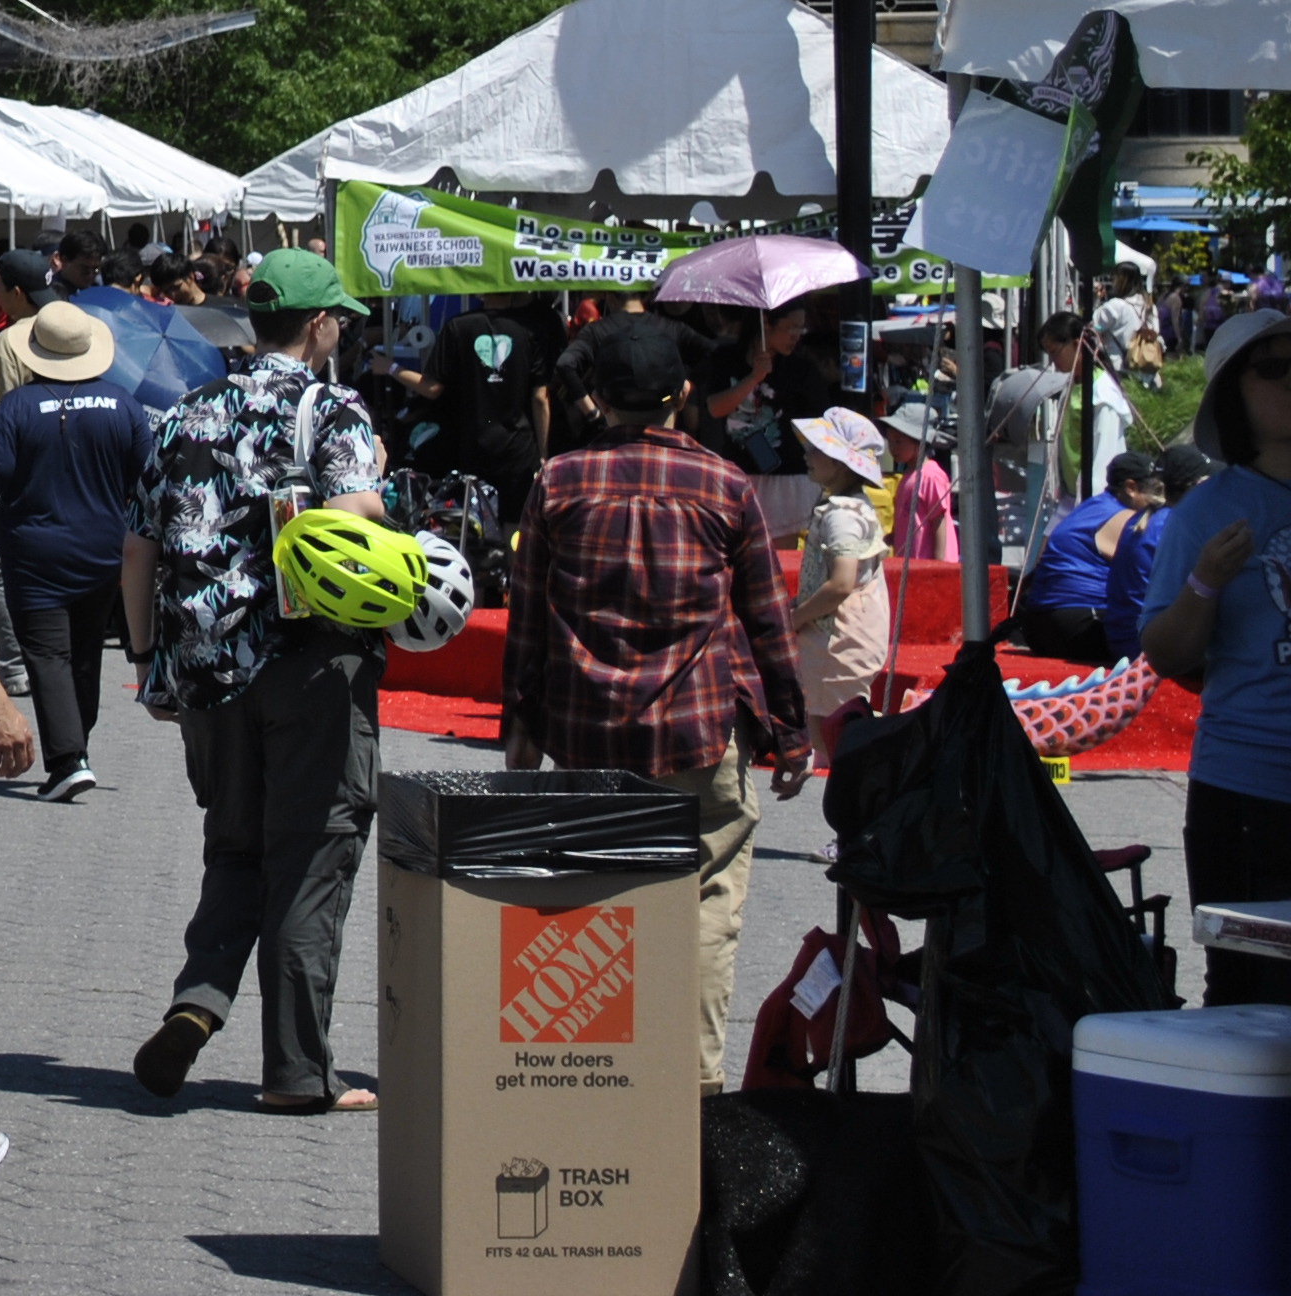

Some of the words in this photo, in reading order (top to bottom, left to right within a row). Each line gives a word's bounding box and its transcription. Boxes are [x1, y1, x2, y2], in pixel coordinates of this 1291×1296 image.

[374, 231, 425, 241] WASHINGTON
[427, 230, 438, 238] DC
[374, 241, 433, 253] TAIWANESE
[436, 239, 480, 251] SCHOOL
[515, 258, 662, 281] Washingto
[73, 396, 117, 410] DEAN
[513, 920, 569, 974] THE
[500, 905, 634, 1042] HOME
[552, 956, 634, 1042] DEPOT
[515, 1051, 556, 1067] How
[561, 1051, 614, 1068] doers
[495, 1072, 525, 1091] get
[530, 1074, 578, 1087] more
[559, 1168, 630, 1185] TRASH
[559, 1190, 604, 1207] BOX
[485, 1246, 513, 1258] FITS
[516, 1246, 530, 1258] 42
[533, 1246, 558, 1258] GAL
[561, 1246, 604, 1257] TRASH
[607, 1245, 642, 1257] BAGS
